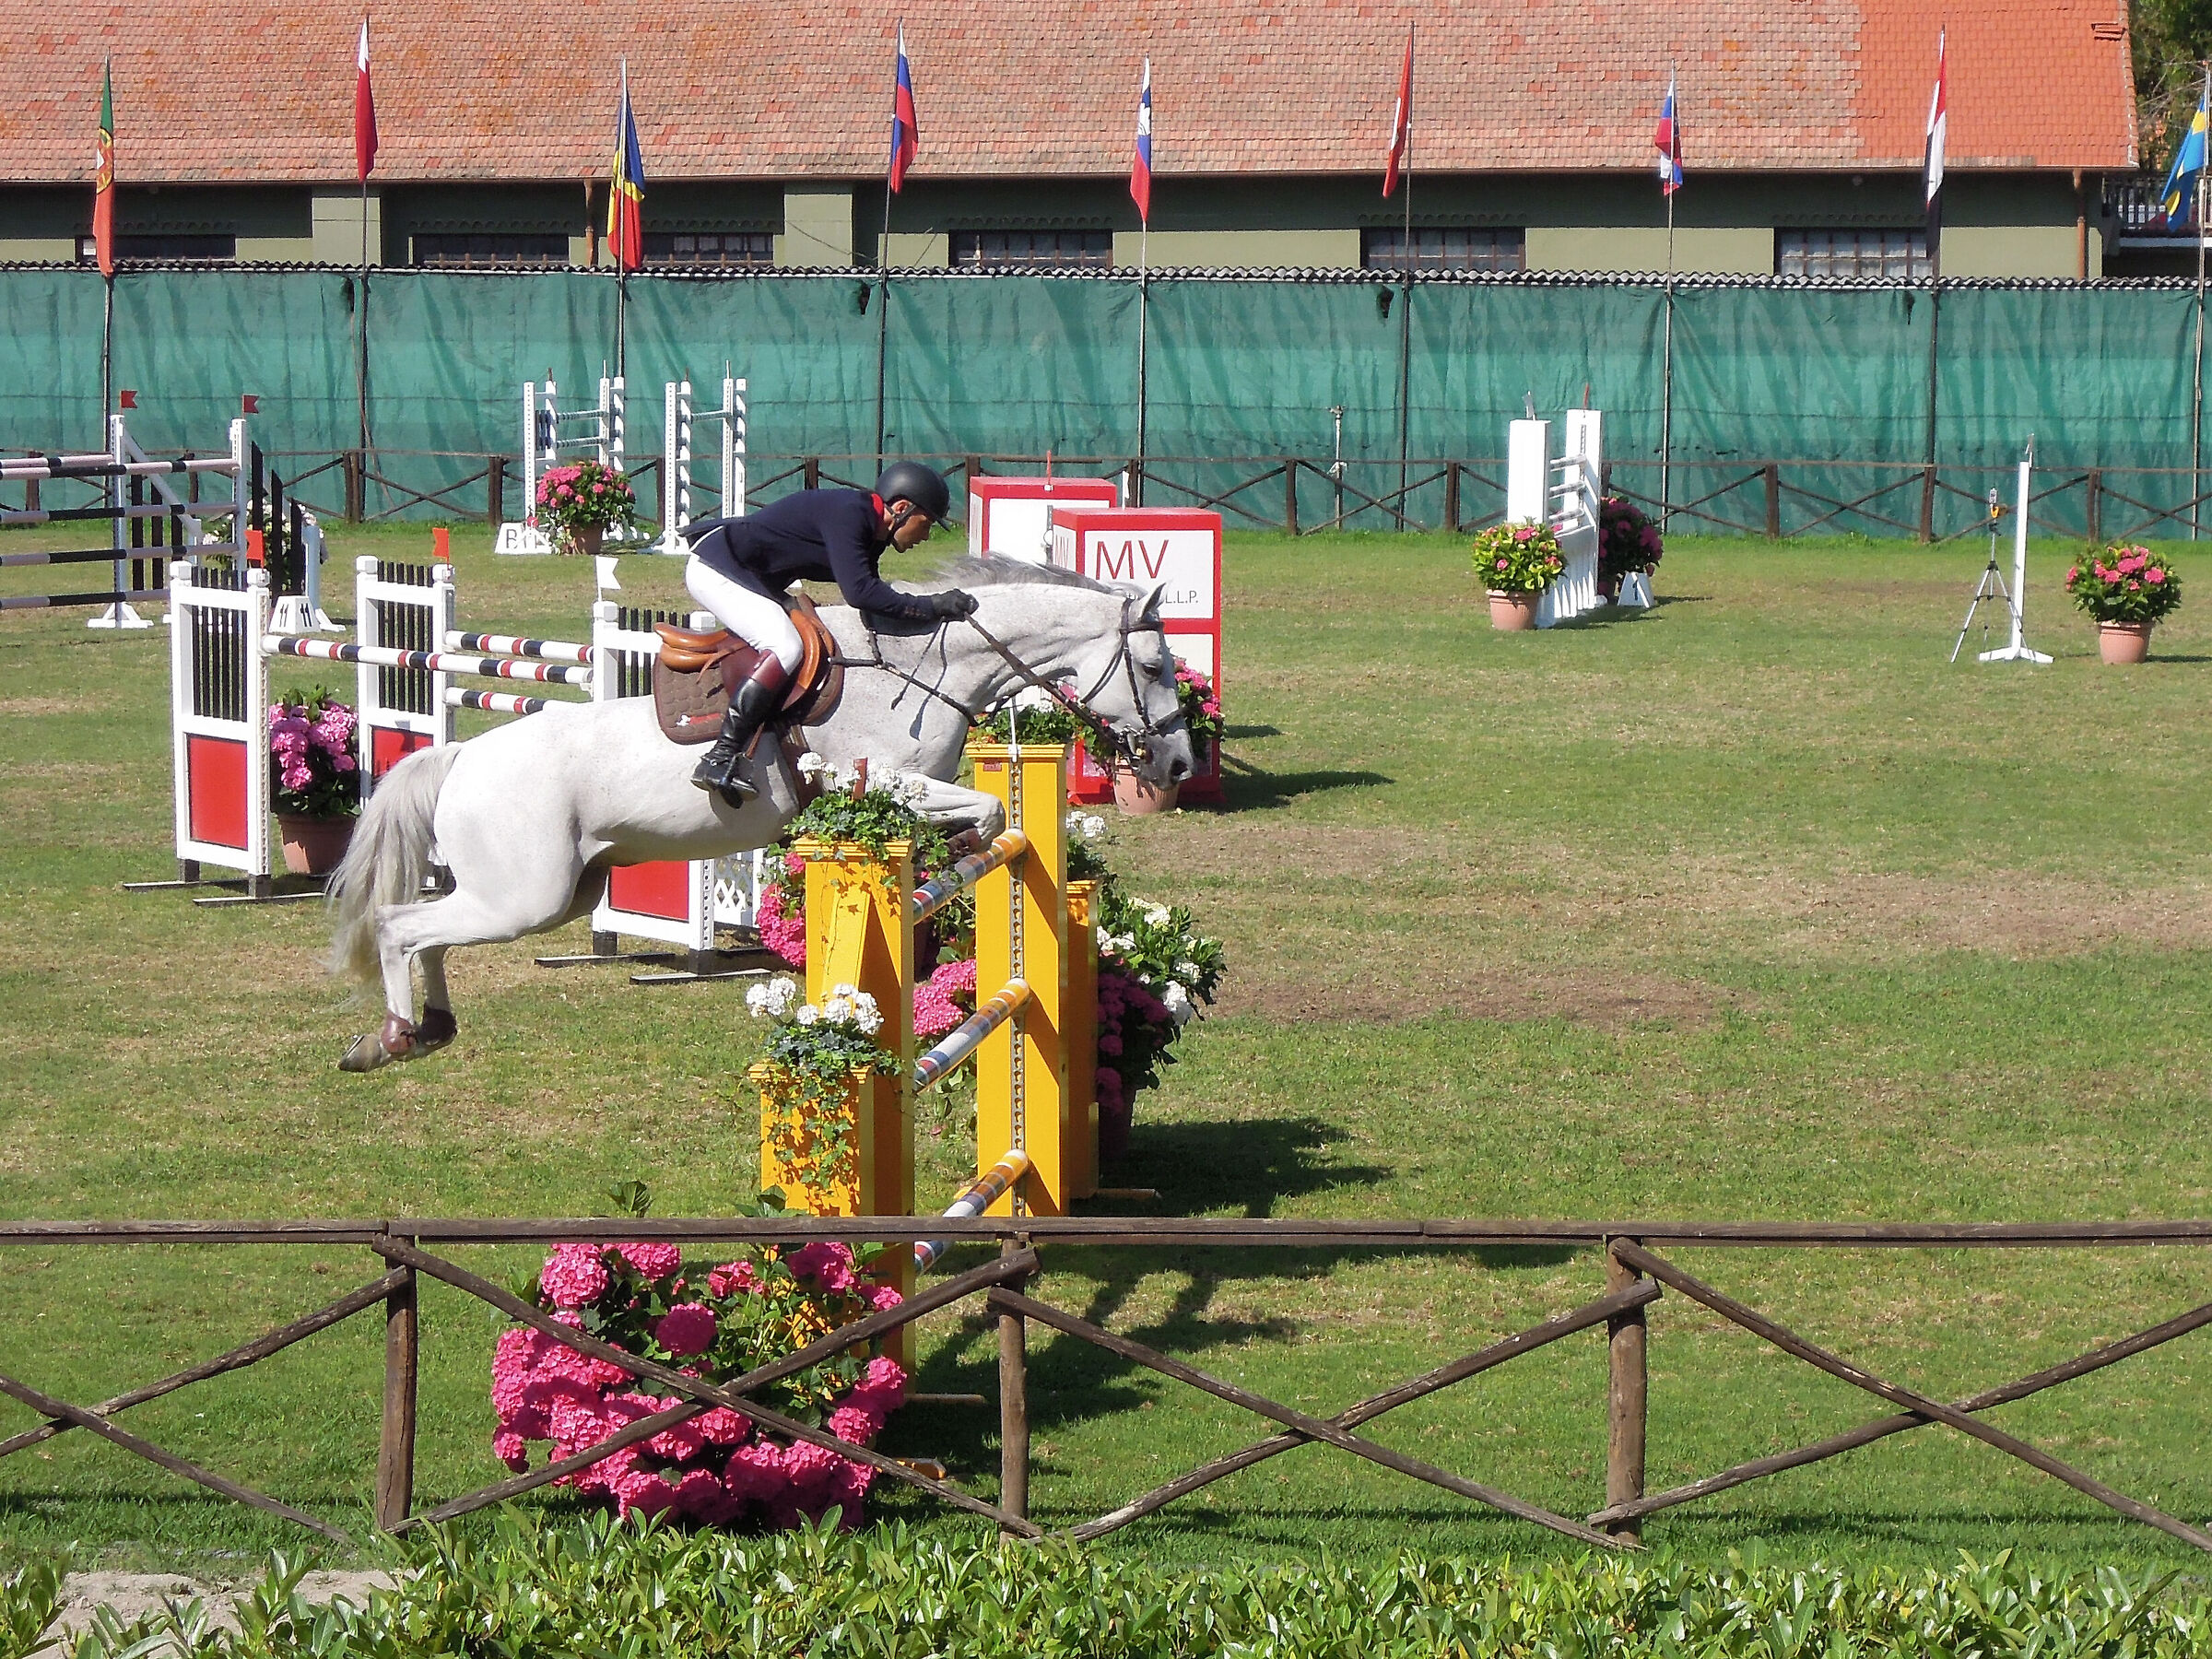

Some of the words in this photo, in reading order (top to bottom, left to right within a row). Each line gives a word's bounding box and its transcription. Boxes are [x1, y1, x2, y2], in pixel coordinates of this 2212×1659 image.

[1096, 539, 1169, 580] MV
[279, 604, 288, 627] 11
[300, 603, 312, 627] 11
